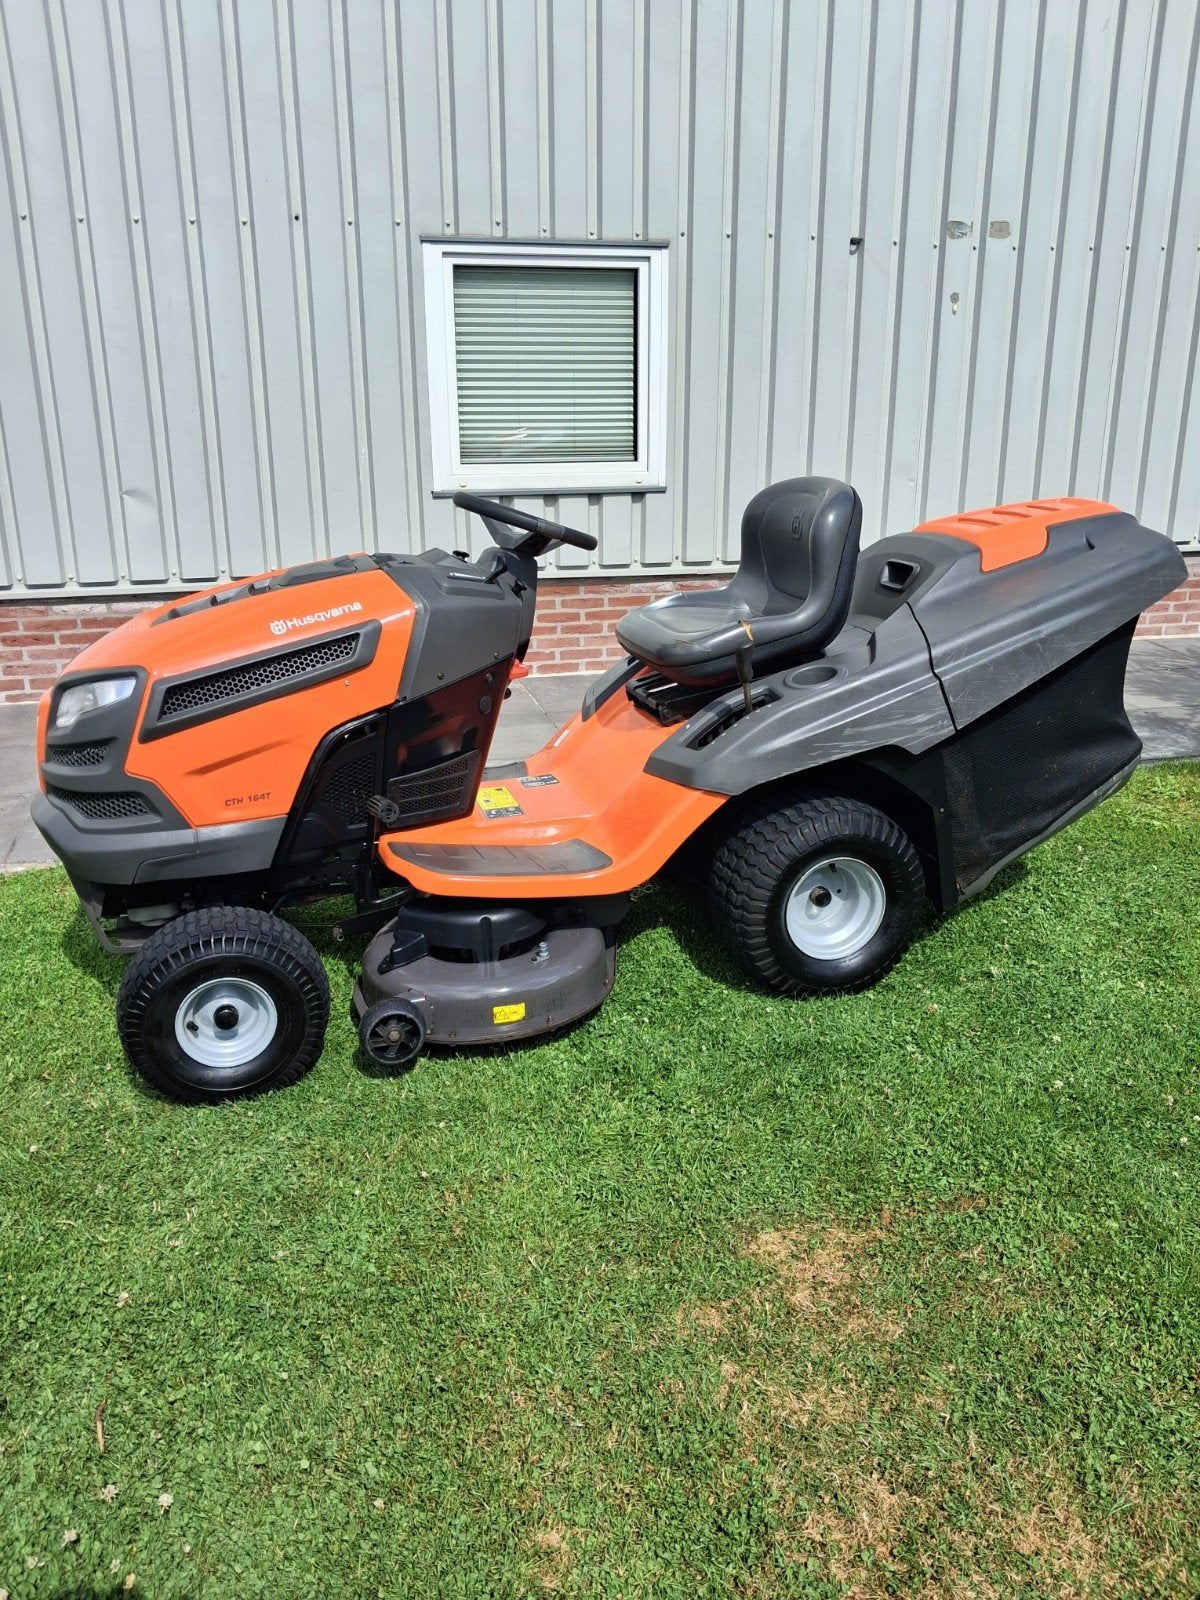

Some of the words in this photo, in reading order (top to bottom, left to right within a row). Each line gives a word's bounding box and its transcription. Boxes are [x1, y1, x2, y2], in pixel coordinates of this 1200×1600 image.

[286, 601, 363, 630] Husqvarna
[224, 797, 244, 807] CTH
[247, 792, 271, 803] 164T
